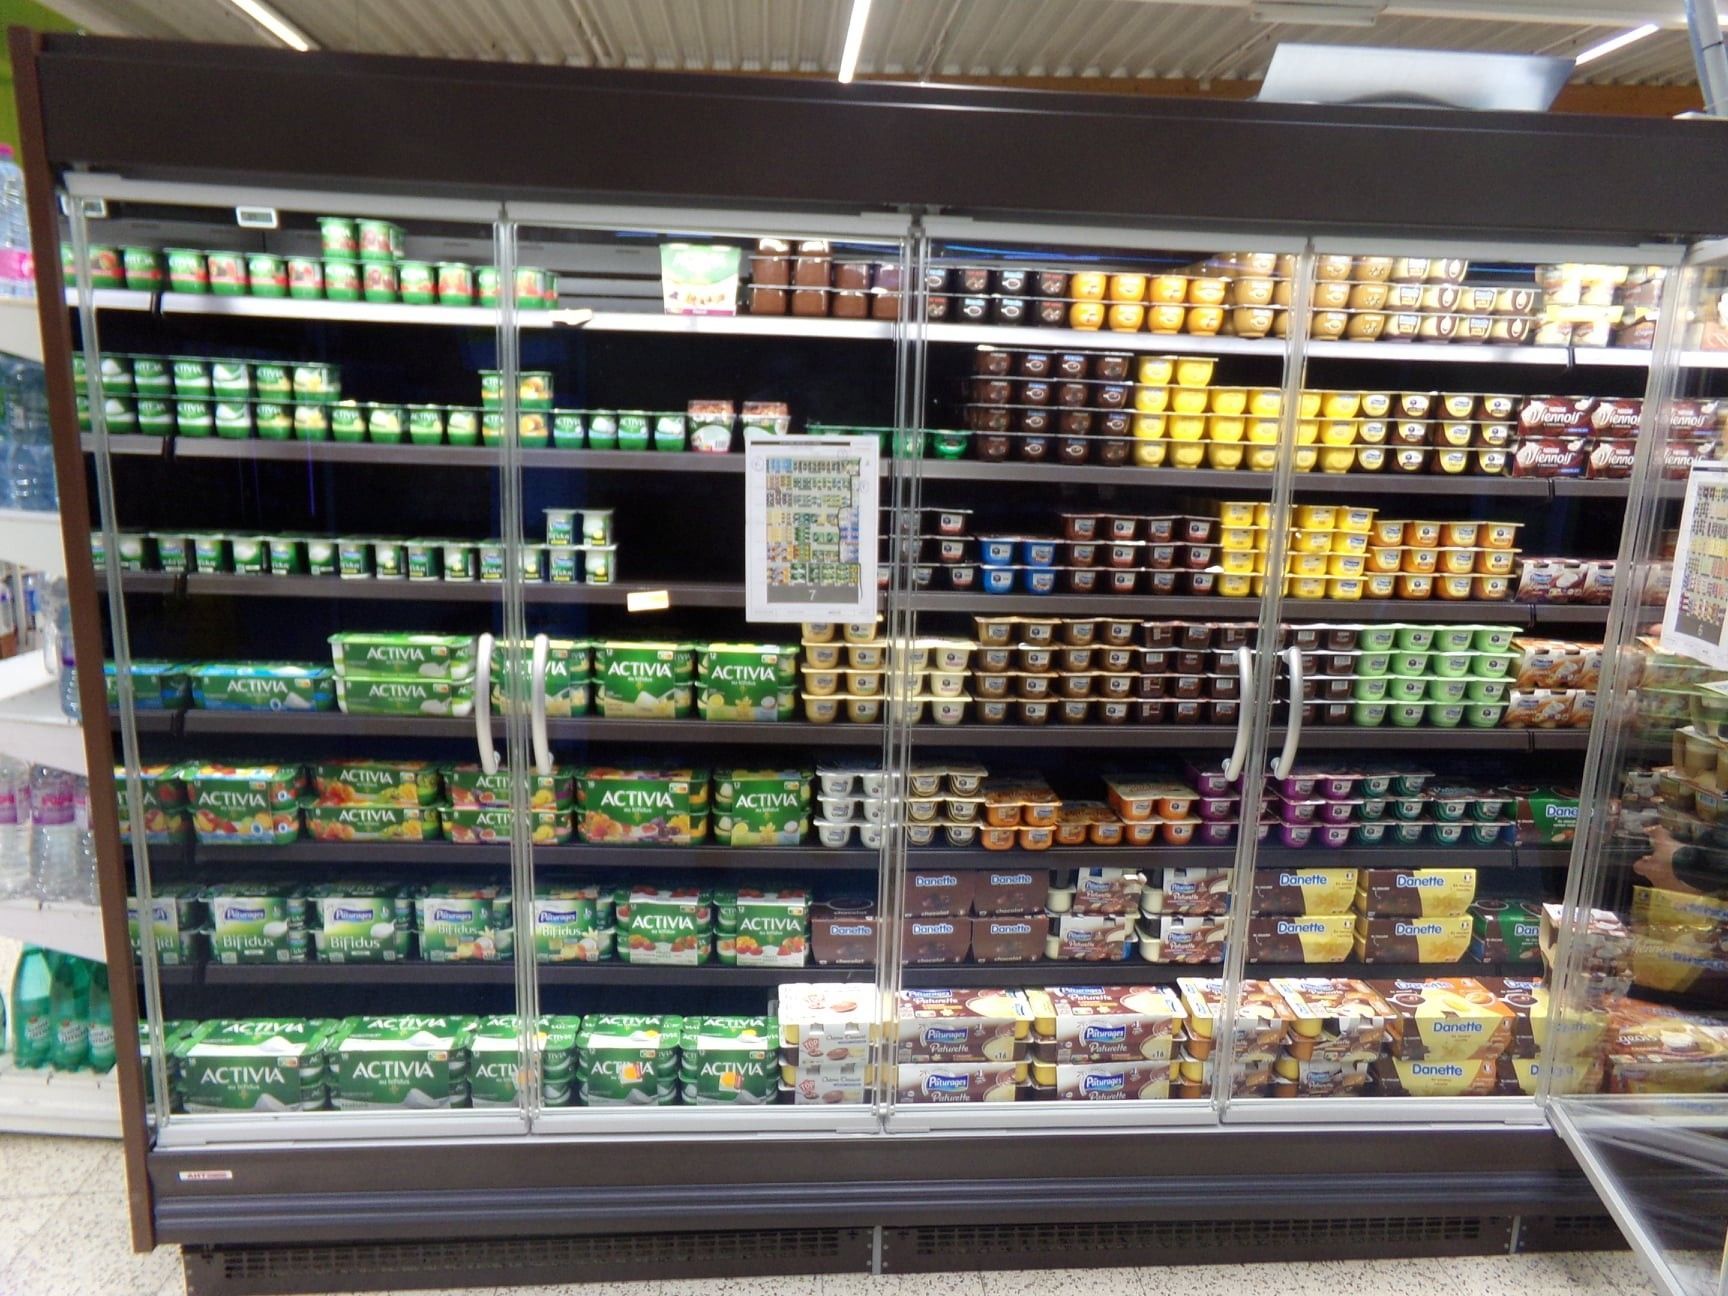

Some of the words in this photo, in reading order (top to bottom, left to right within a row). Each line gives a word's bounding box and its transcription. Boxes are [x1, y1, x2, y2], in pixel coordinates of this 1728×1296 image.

[808, 589, 816, 600] 7
[367, 646, 425, 661] ACTIVIA
[608, 661, 672, 677] ACTIVIA
[711, 665, 775, 681] ACTIVIA
[227, 679, 288, 693] ACTIVIA
[369, 684, 427, 698] ACTIVIA
[340, 769, 393, 784] ACTIVIA
[198, 791, 267, 807] ACTIVIA
[600, 790, 674, 808] ACTIVIA
[735, 793, 798, 809] ACTIVIA
[339, 809, 396, 822] ACTIVIA
[916, 875, 957, 887] Danette
[991, 874, 1032, 886] Danette
[1280, 873, 1327, 886] Danette
[1397, 875, 1444, 887] Danette
[632, 915, 694, 930] ACTIVIA
[740, 917, 801, 931] ACTIVIA
[991, 924, 1031, 934] Danette
[1277, 922, 1325, 934] Danette
[830, 925, 872, 935] Danette
[912, 924, 953, 935] Danette
[1395, 923, 1442, 936] Danette
[367, 1017, 447, 1029] ACTIVIA
[599, 1017, 660, 1025] ACTIVIA
[705, 1019, 765, 1027] ACTIVIA
[1433, 1021, 1482, 1033] Danette
[222, 1022, 305, 1034] ACTIVIA
[1086, 1027, 1124, 1039] Pâturages
[927, 1029, 966, 1041] Pâturages
[352, 1061, 435, 1079] ACTIVIA
[701, 1062, 763, 1075] ACTIVIA
[1412, 1063, 1463, 1076] Danette
[201, 1067, 285, 1084] ACTIVIA
[928, 1076, 967, 1088] Pâturages
[1085, 1076, 1122, 1087] Pâturages
